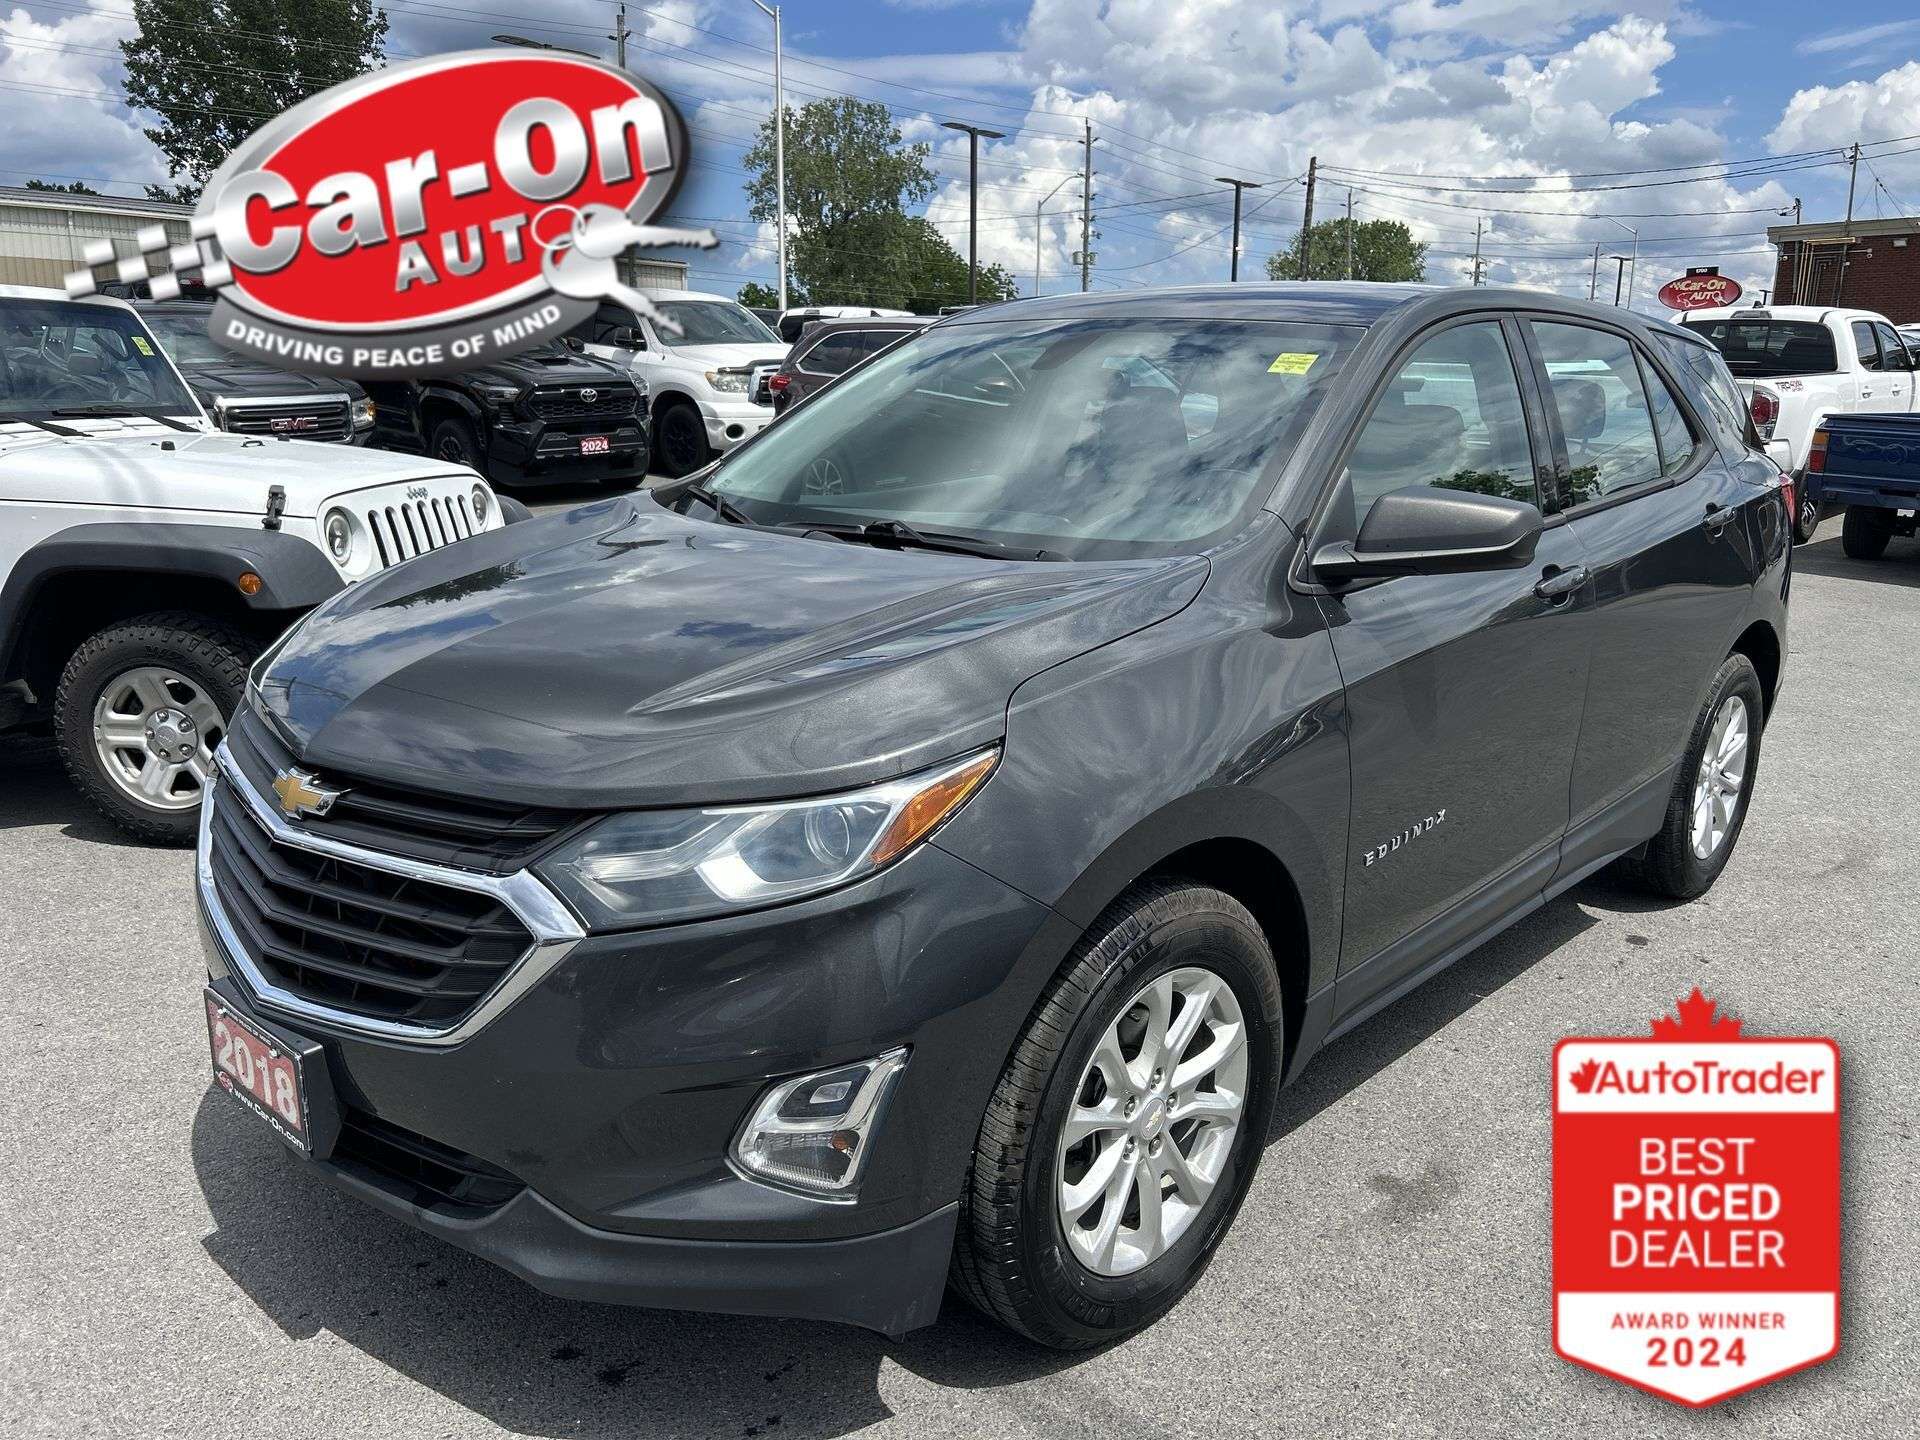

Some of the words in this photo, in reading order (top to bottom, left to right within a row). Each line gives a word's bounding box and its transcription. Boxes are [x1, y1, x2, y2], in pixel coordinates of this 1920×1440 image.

[1681, 279, 1727, 291] Car-On
[271, 416, 319, 431] GMC
[581, 440, 609, 452] 2024
[1363, 808, 1446, 867] EQUINOX
[214, 1021, 298, 1125] 2018
[233, 1089, 305, 1151] www.Car-On.com
